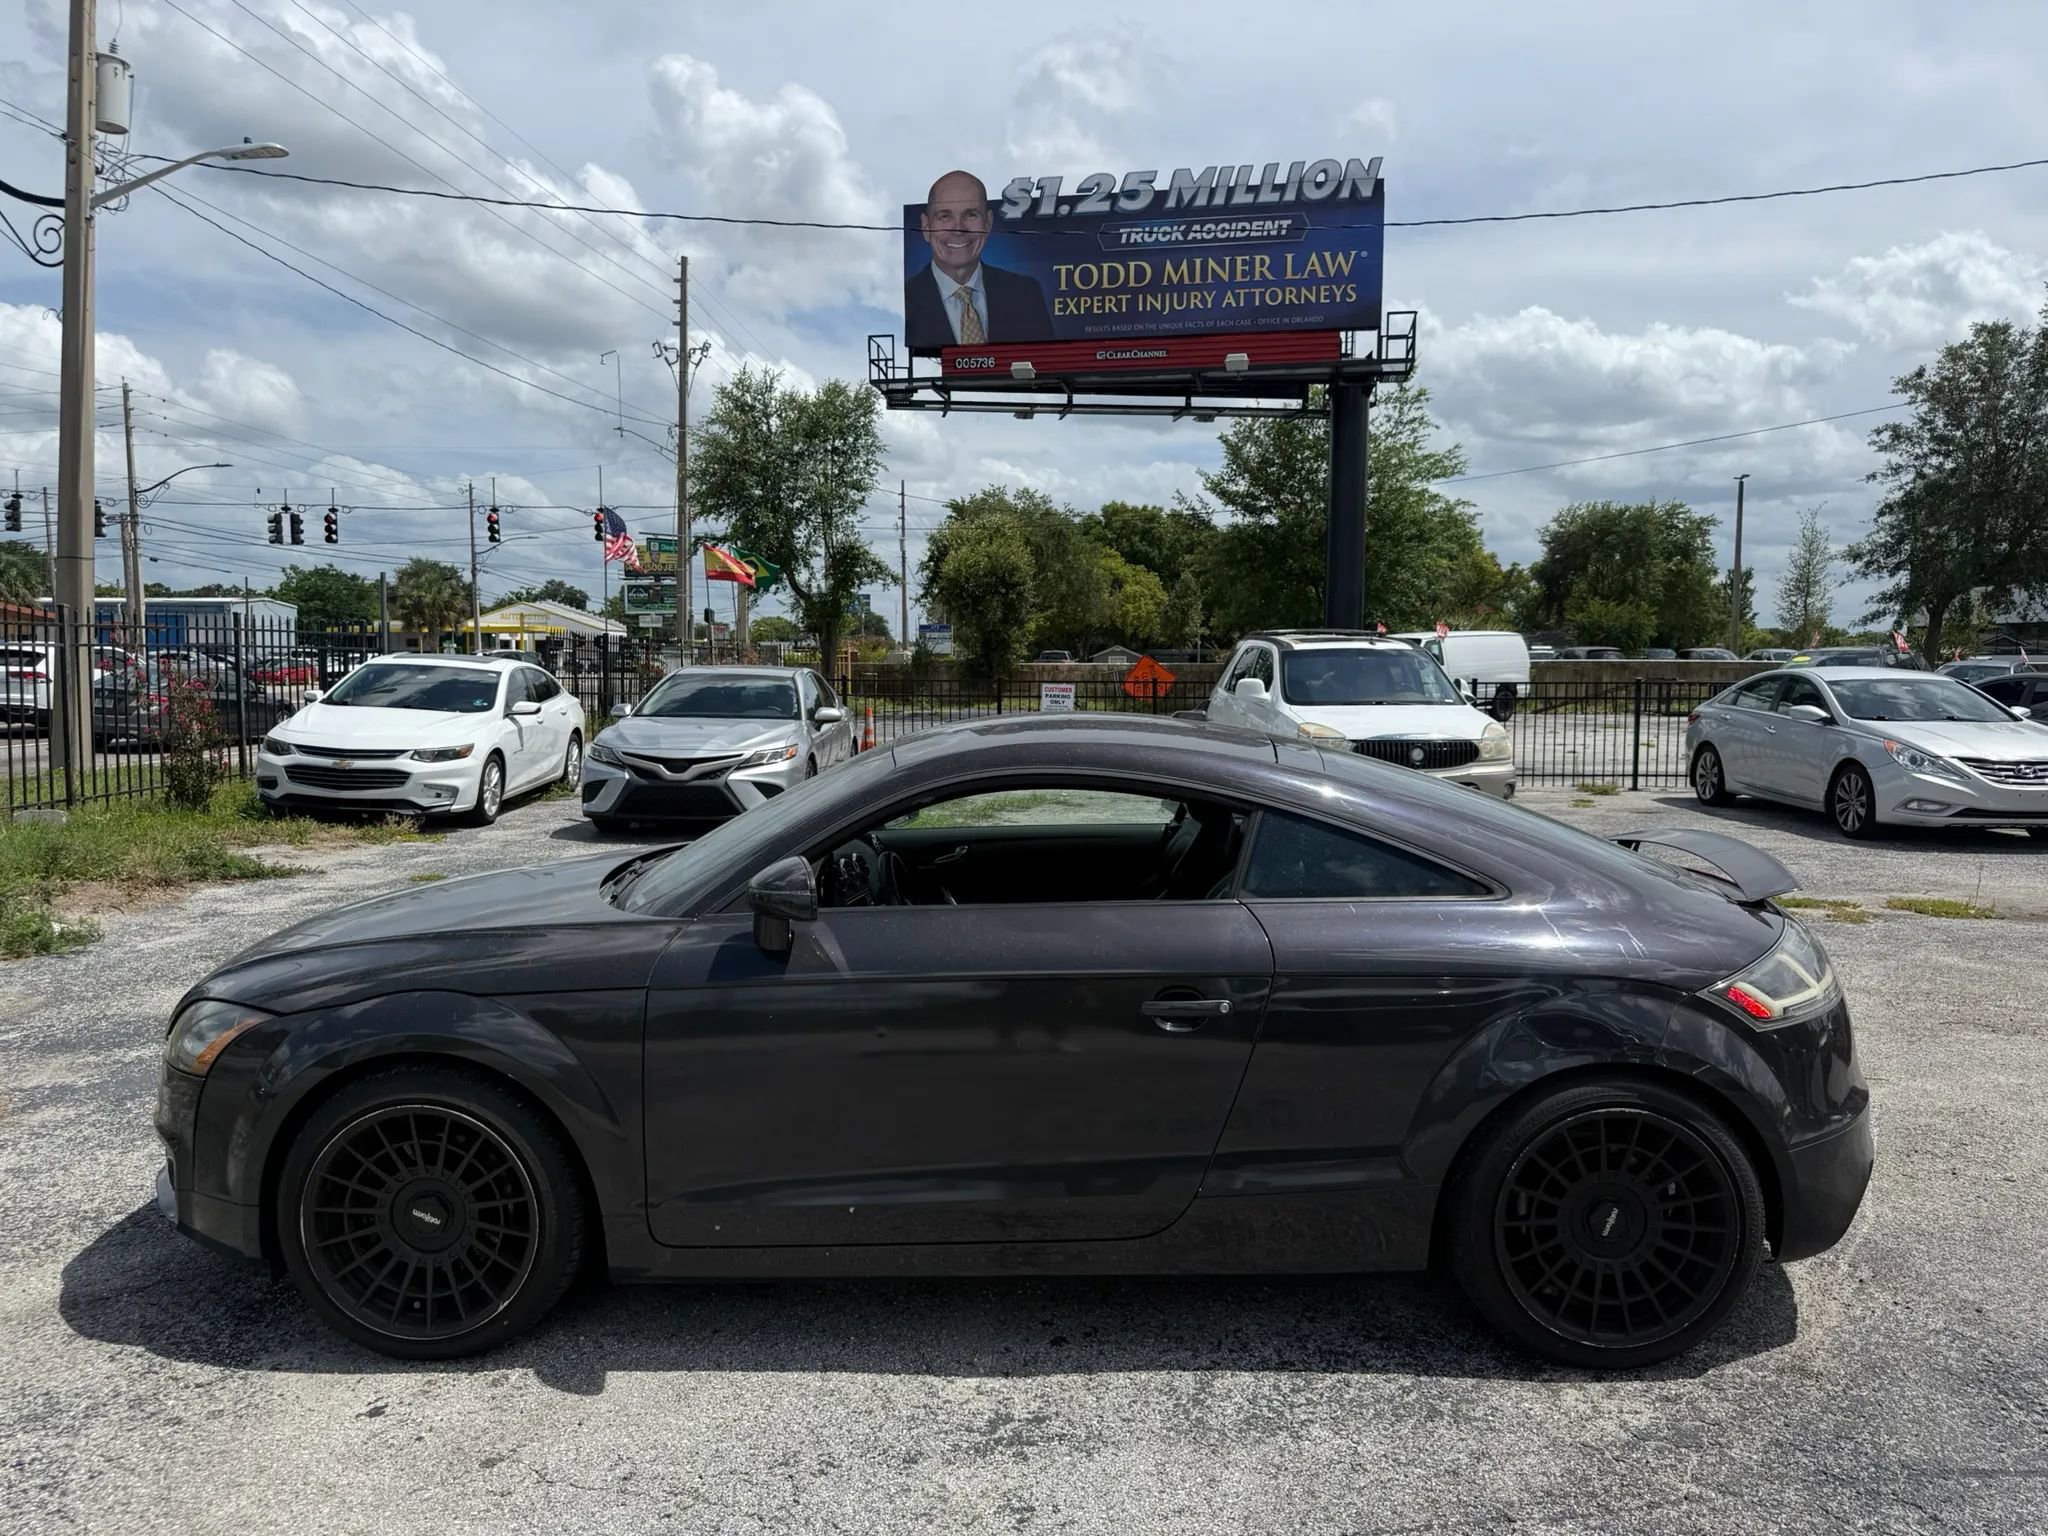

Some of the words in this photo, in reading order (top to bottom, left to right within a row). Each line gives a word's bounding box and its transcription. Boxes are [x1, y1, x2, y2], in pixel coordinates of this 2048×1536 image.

[1000, 170, 1158, 220] $1.25
[1164, 157, 1384, 209] MILLION
[1119, 224, 1186, 244] TRUCK
[1187, 219, 1292, 241] ACCIDENT
[1053, 261, 1152, 291] TODD
[1161, 254, 1277, 286] MINER
[1054, 294, 1132, 316] EXPERT
[1138, 290, 1217, 315] INJURY
[1222, 283, 1357, 309] ATTORNEYS
[1085, 325, 1111, 333] RESULTS
[1112, 324, 1133, 332] BASED
[1133, 323, 1144, 331] ON
[1145, 322, 1157, 330] THE
[1158, 321, 1184, 330] UNIQUE
[1185, 320, 1204, 328] FACTS
[1216, 319, 1234, 328] EACH
[1235, 318, 1252, 327] CASE
[1257, 317, 1280, 326] OFFICE
[1291, 315, 1324, 324] ORLANDO
[955, 357, 996, 369] 005736
[412, 1208, 441, 1225] rotiform
[1601, 1207, 1619, 1237] rotiform
